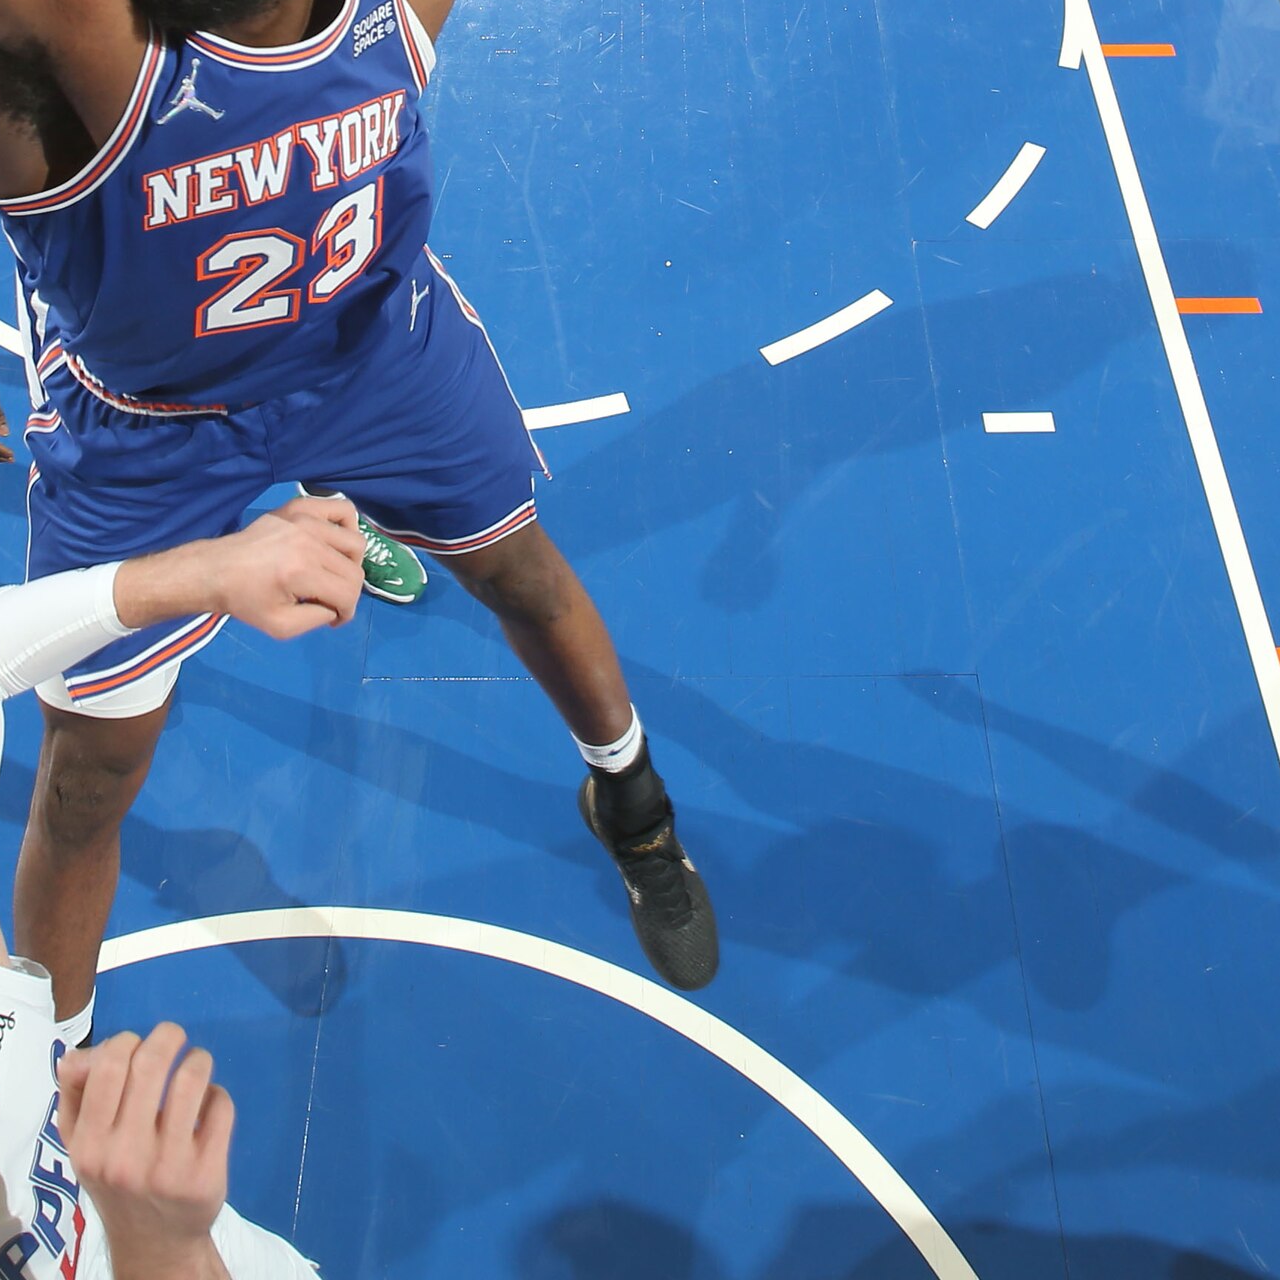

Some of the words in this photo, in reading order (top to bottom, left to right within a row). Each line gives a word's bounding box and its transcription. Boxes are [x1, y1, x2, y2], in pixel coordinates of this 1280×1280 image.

[353, 0, 394, 41] SQUARE
[353, 23, 386, 58] SPACE
[143, 130, 296, 232] NEW
[294, 88, 407, 193] YORK
[195, 175, 385, 339] 23
